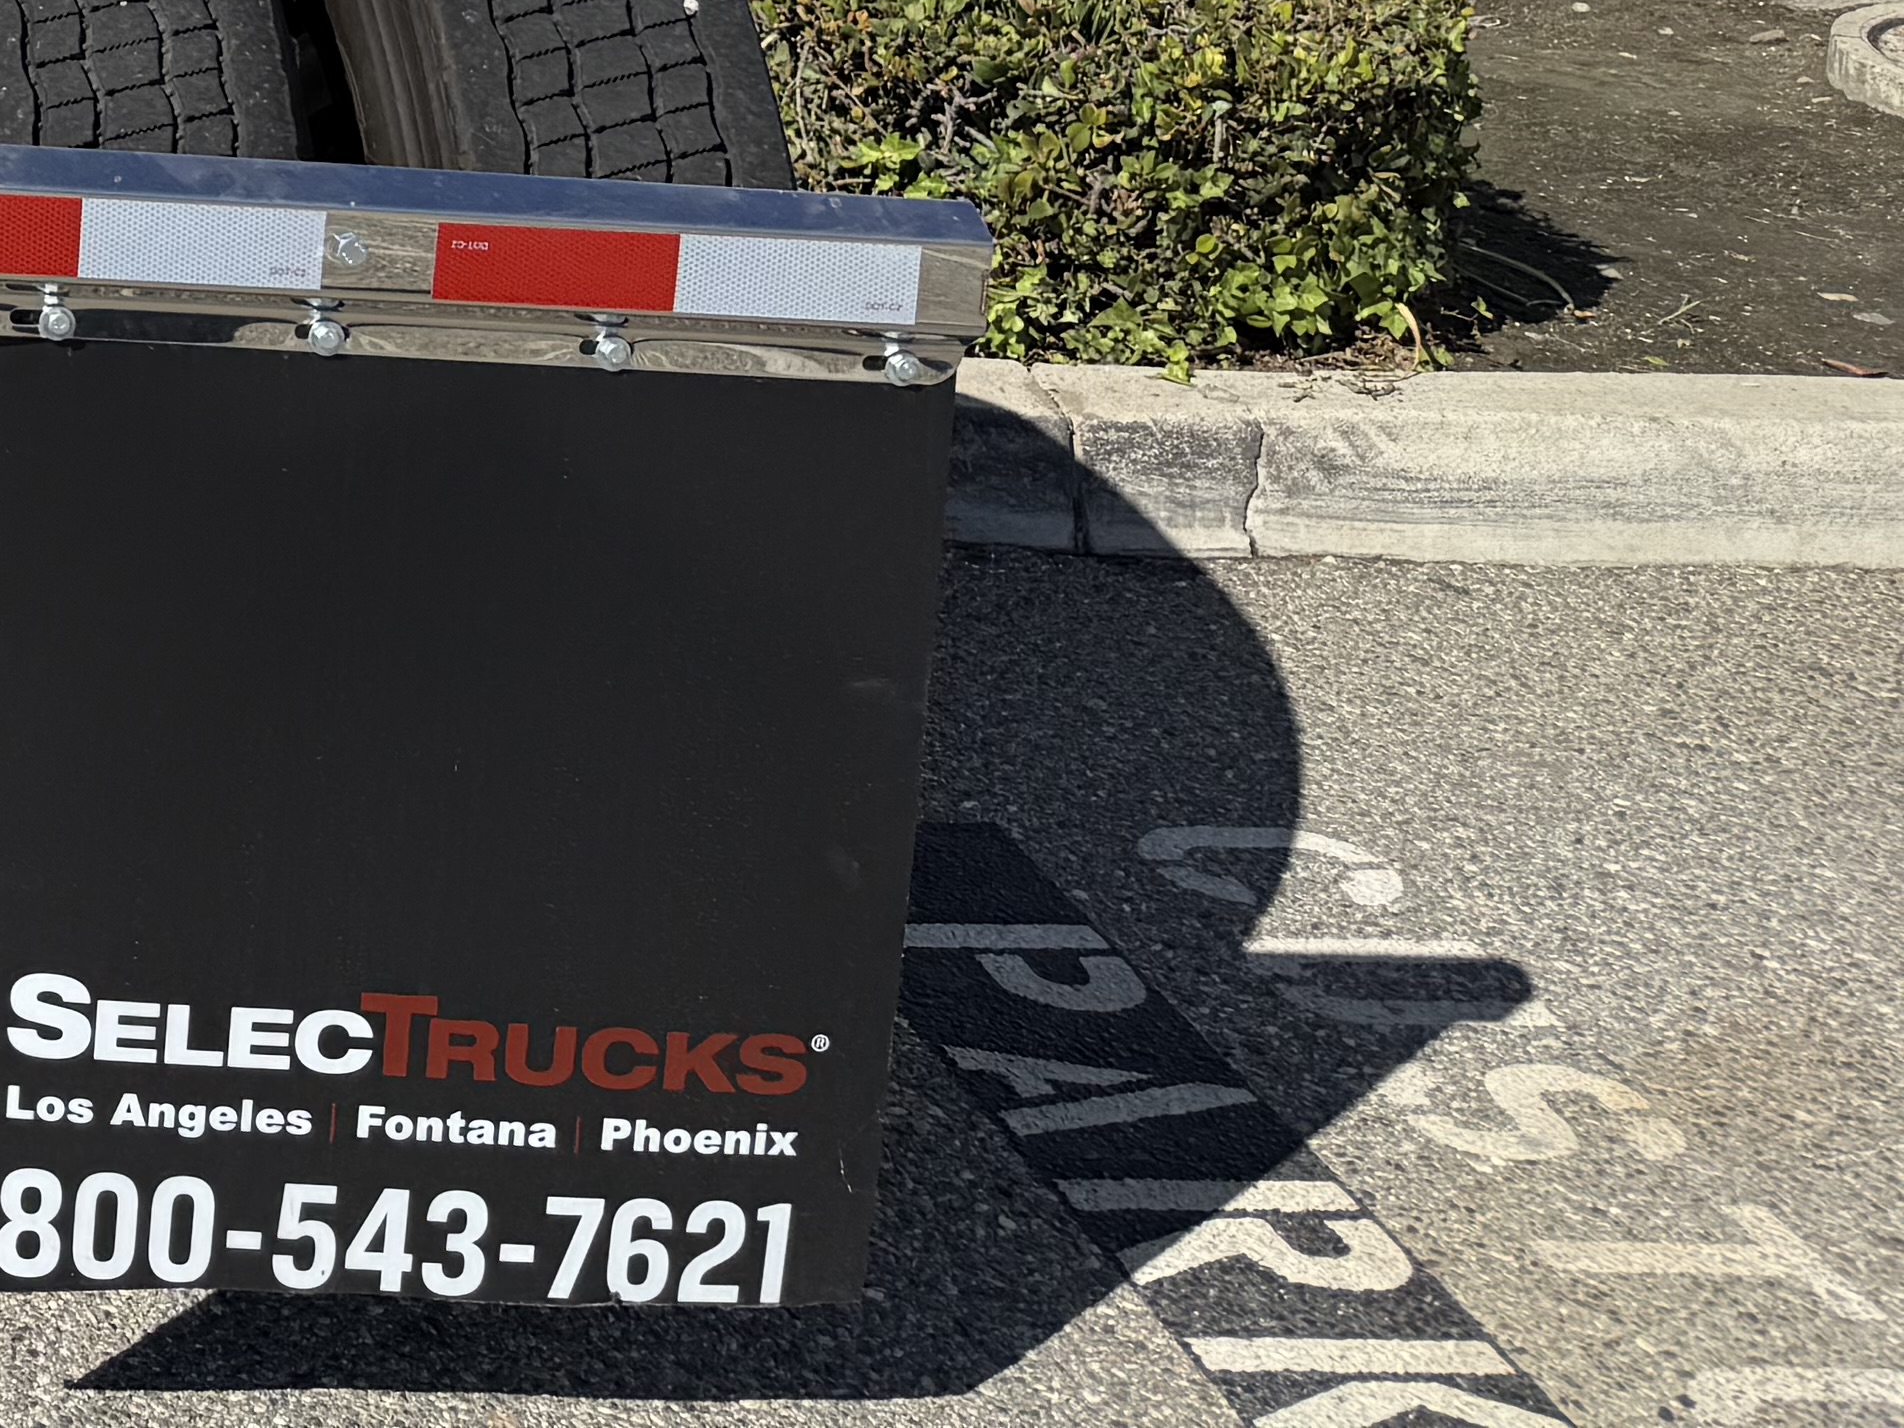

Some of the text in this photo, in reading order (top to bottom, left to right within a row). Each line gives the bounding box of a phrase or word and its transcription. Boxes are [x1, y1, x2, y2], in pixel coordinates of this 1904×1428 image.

[5, 1084, 799, 1157] Los Angeles Fontana Phoenix
[1139, 825, 1904, 1428] CUST
